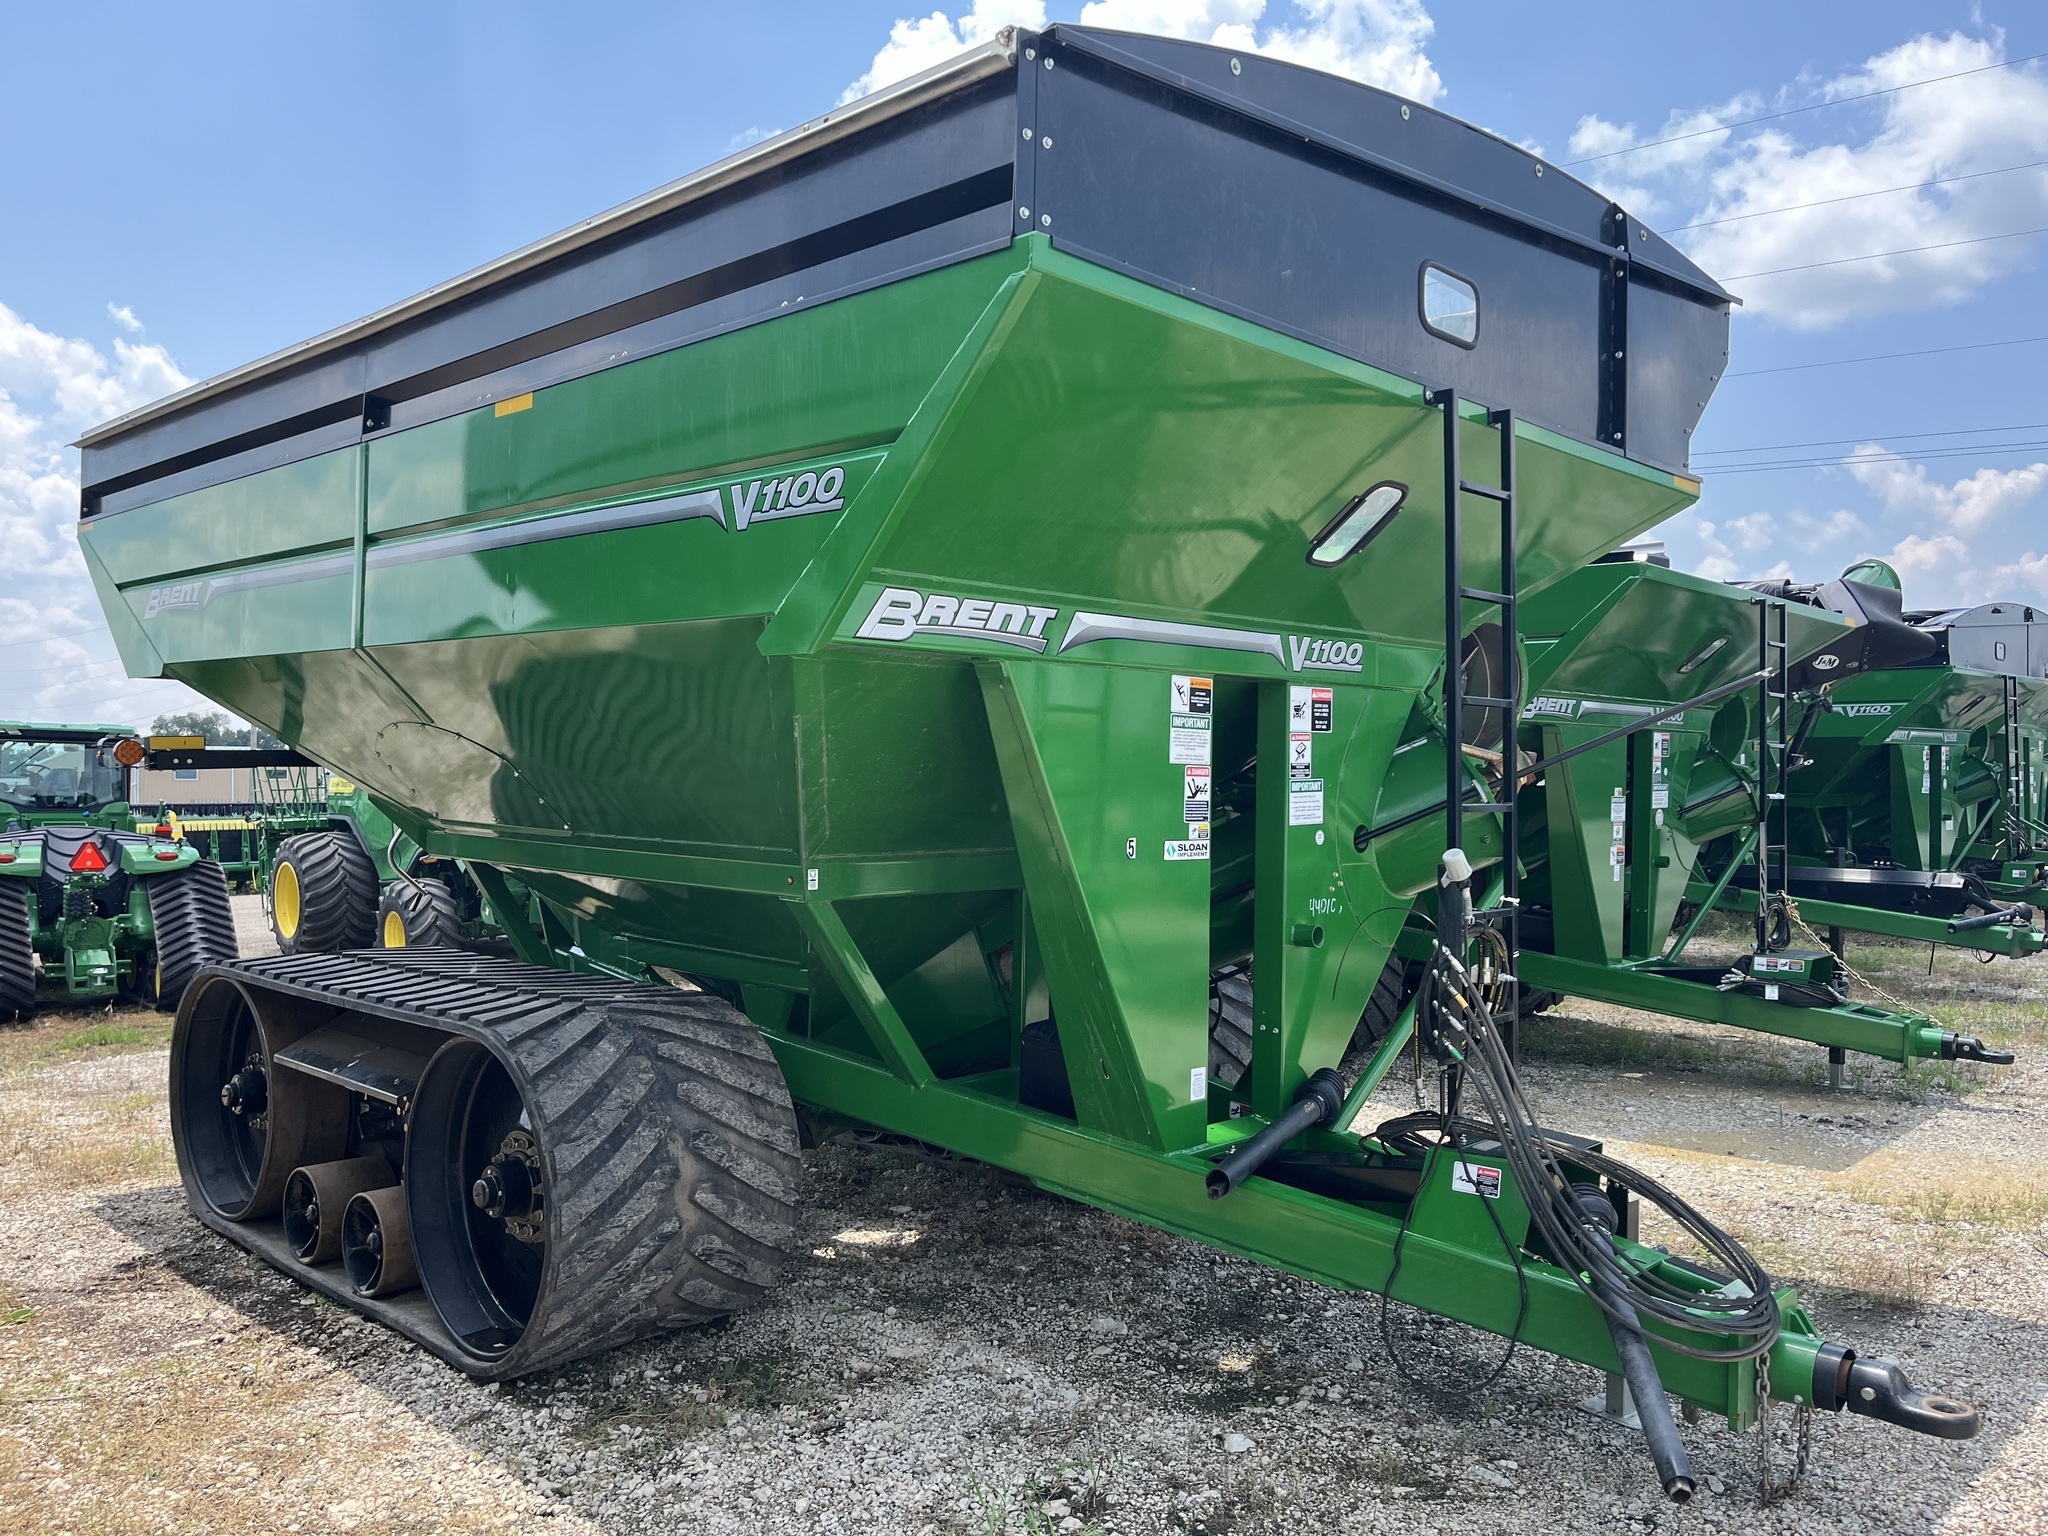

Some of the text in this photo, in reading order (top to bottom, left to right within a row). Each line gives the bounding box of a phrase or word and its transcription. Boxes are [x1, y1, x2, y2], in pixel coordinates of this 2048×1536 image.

[730, 466, 845, 532] V1100
[143, 581, 203, 620] BRENT
[852, 586, 1059, 642] BRENT
[1288, 635, 1363, 672] V1100
[1846, 705, 1891, 718] V1100
[1172, 716, 1209, 729] IMPORTANT
[1291, 781, 1322, 792] IMPORTANT
[1128, 839, 1135, 857] 5
[1177, 843, 1208, 852] SLOAN
